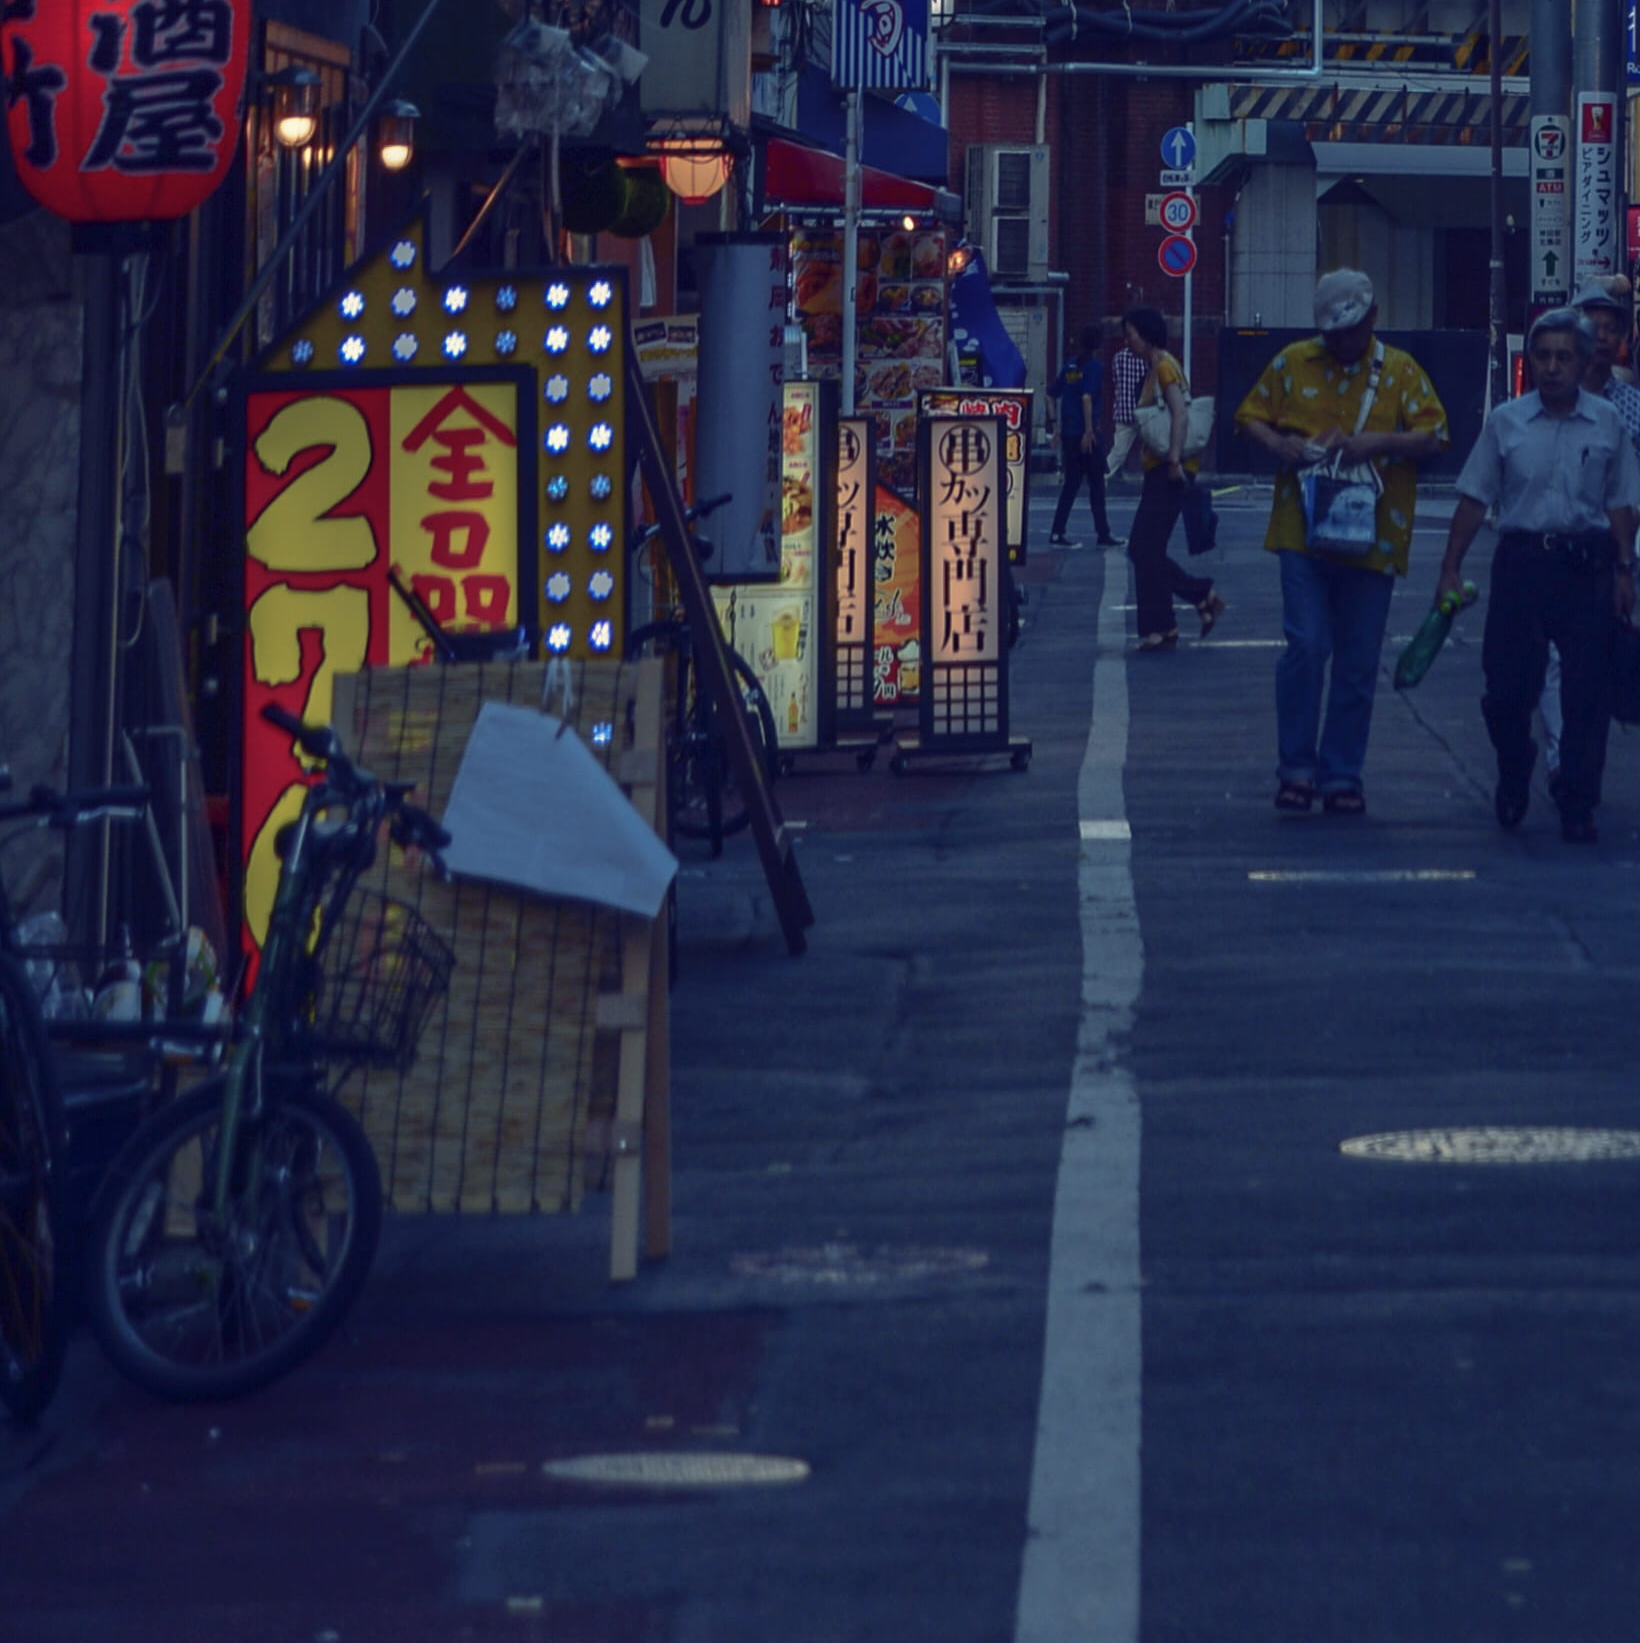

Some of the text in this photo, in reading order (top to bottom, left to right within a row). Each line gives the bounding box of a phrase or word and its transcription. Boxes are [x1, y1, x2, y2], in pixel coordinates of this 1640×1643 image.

[1167, 203, 1189, 222] 30
[1581, 146, 1593, 245] ビアダイニング
[1596, 147, 1612, 248] シュマッツ
[939, 427, 991, 653] 串カツ専門店
